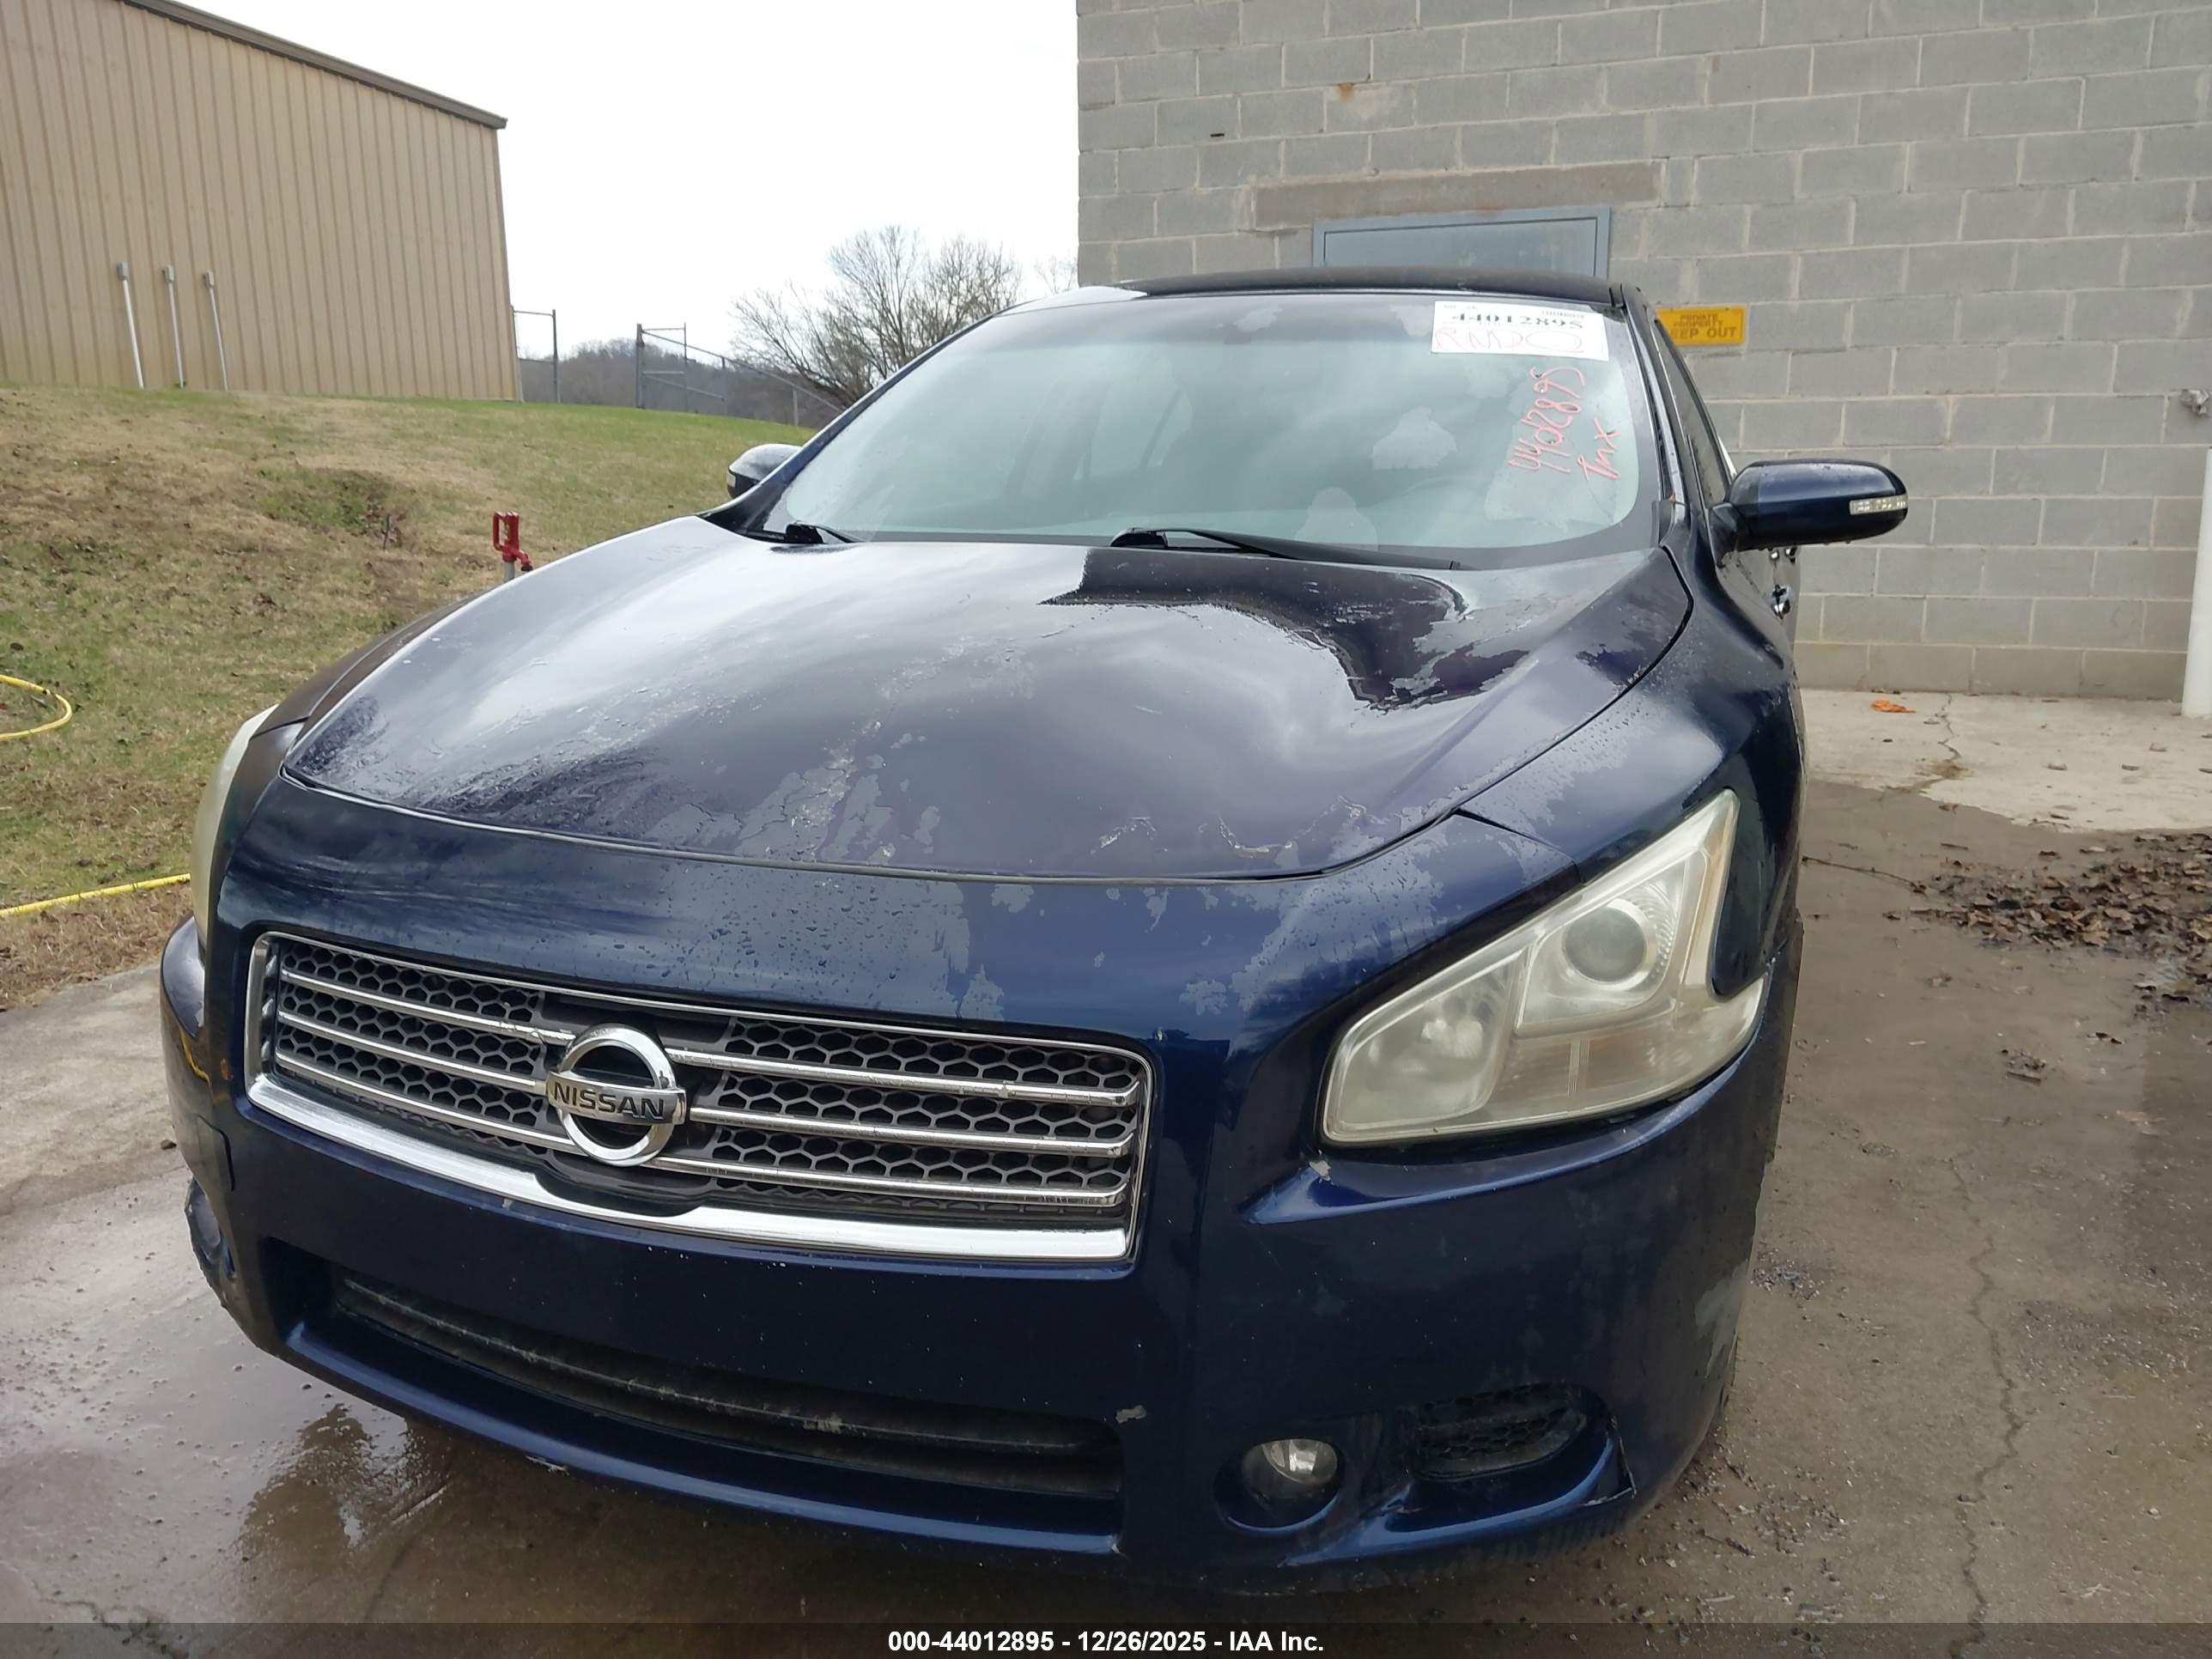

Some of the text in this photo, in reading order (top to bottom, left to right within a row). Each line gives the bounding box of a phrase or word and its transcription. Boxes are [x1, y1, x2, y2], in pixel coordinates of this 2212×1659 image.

[1670, 326, 1737, 340] EEP OUT
[553, 1082, 665, 1118] NISSAN
